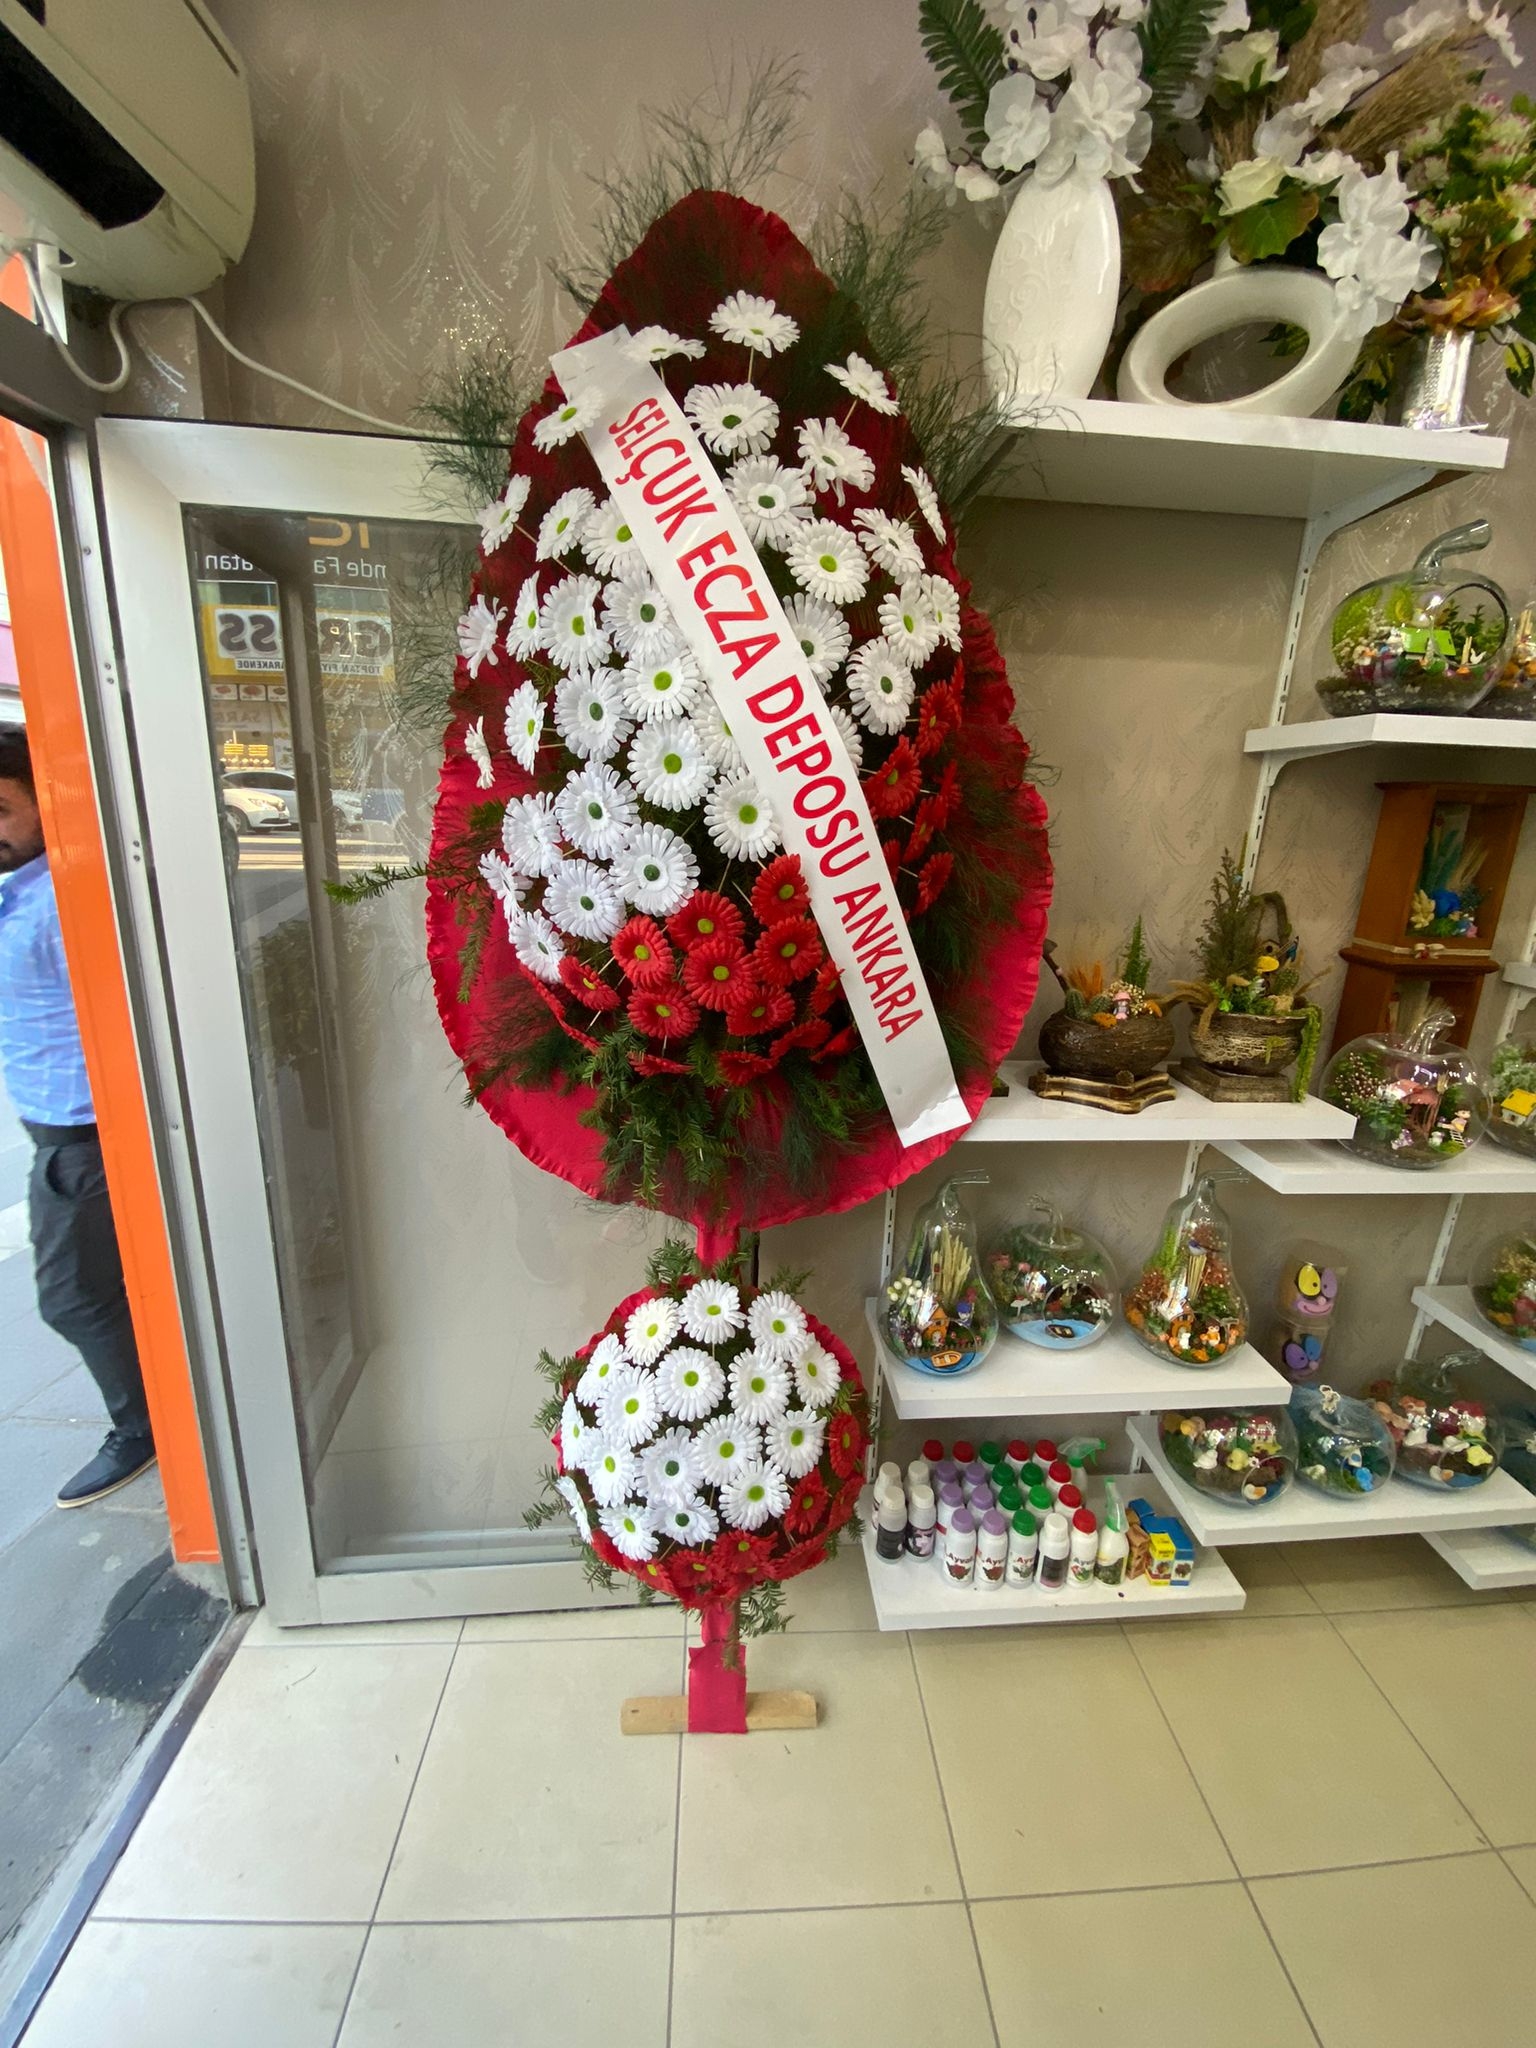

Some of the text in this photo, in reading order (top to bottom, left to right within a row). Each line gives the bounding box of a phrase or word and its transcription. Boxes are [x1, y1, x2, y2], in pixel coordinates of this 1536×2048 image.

[607, 397, 924, 1043] SELÇUK ECZA DEPOSU ANKARA
